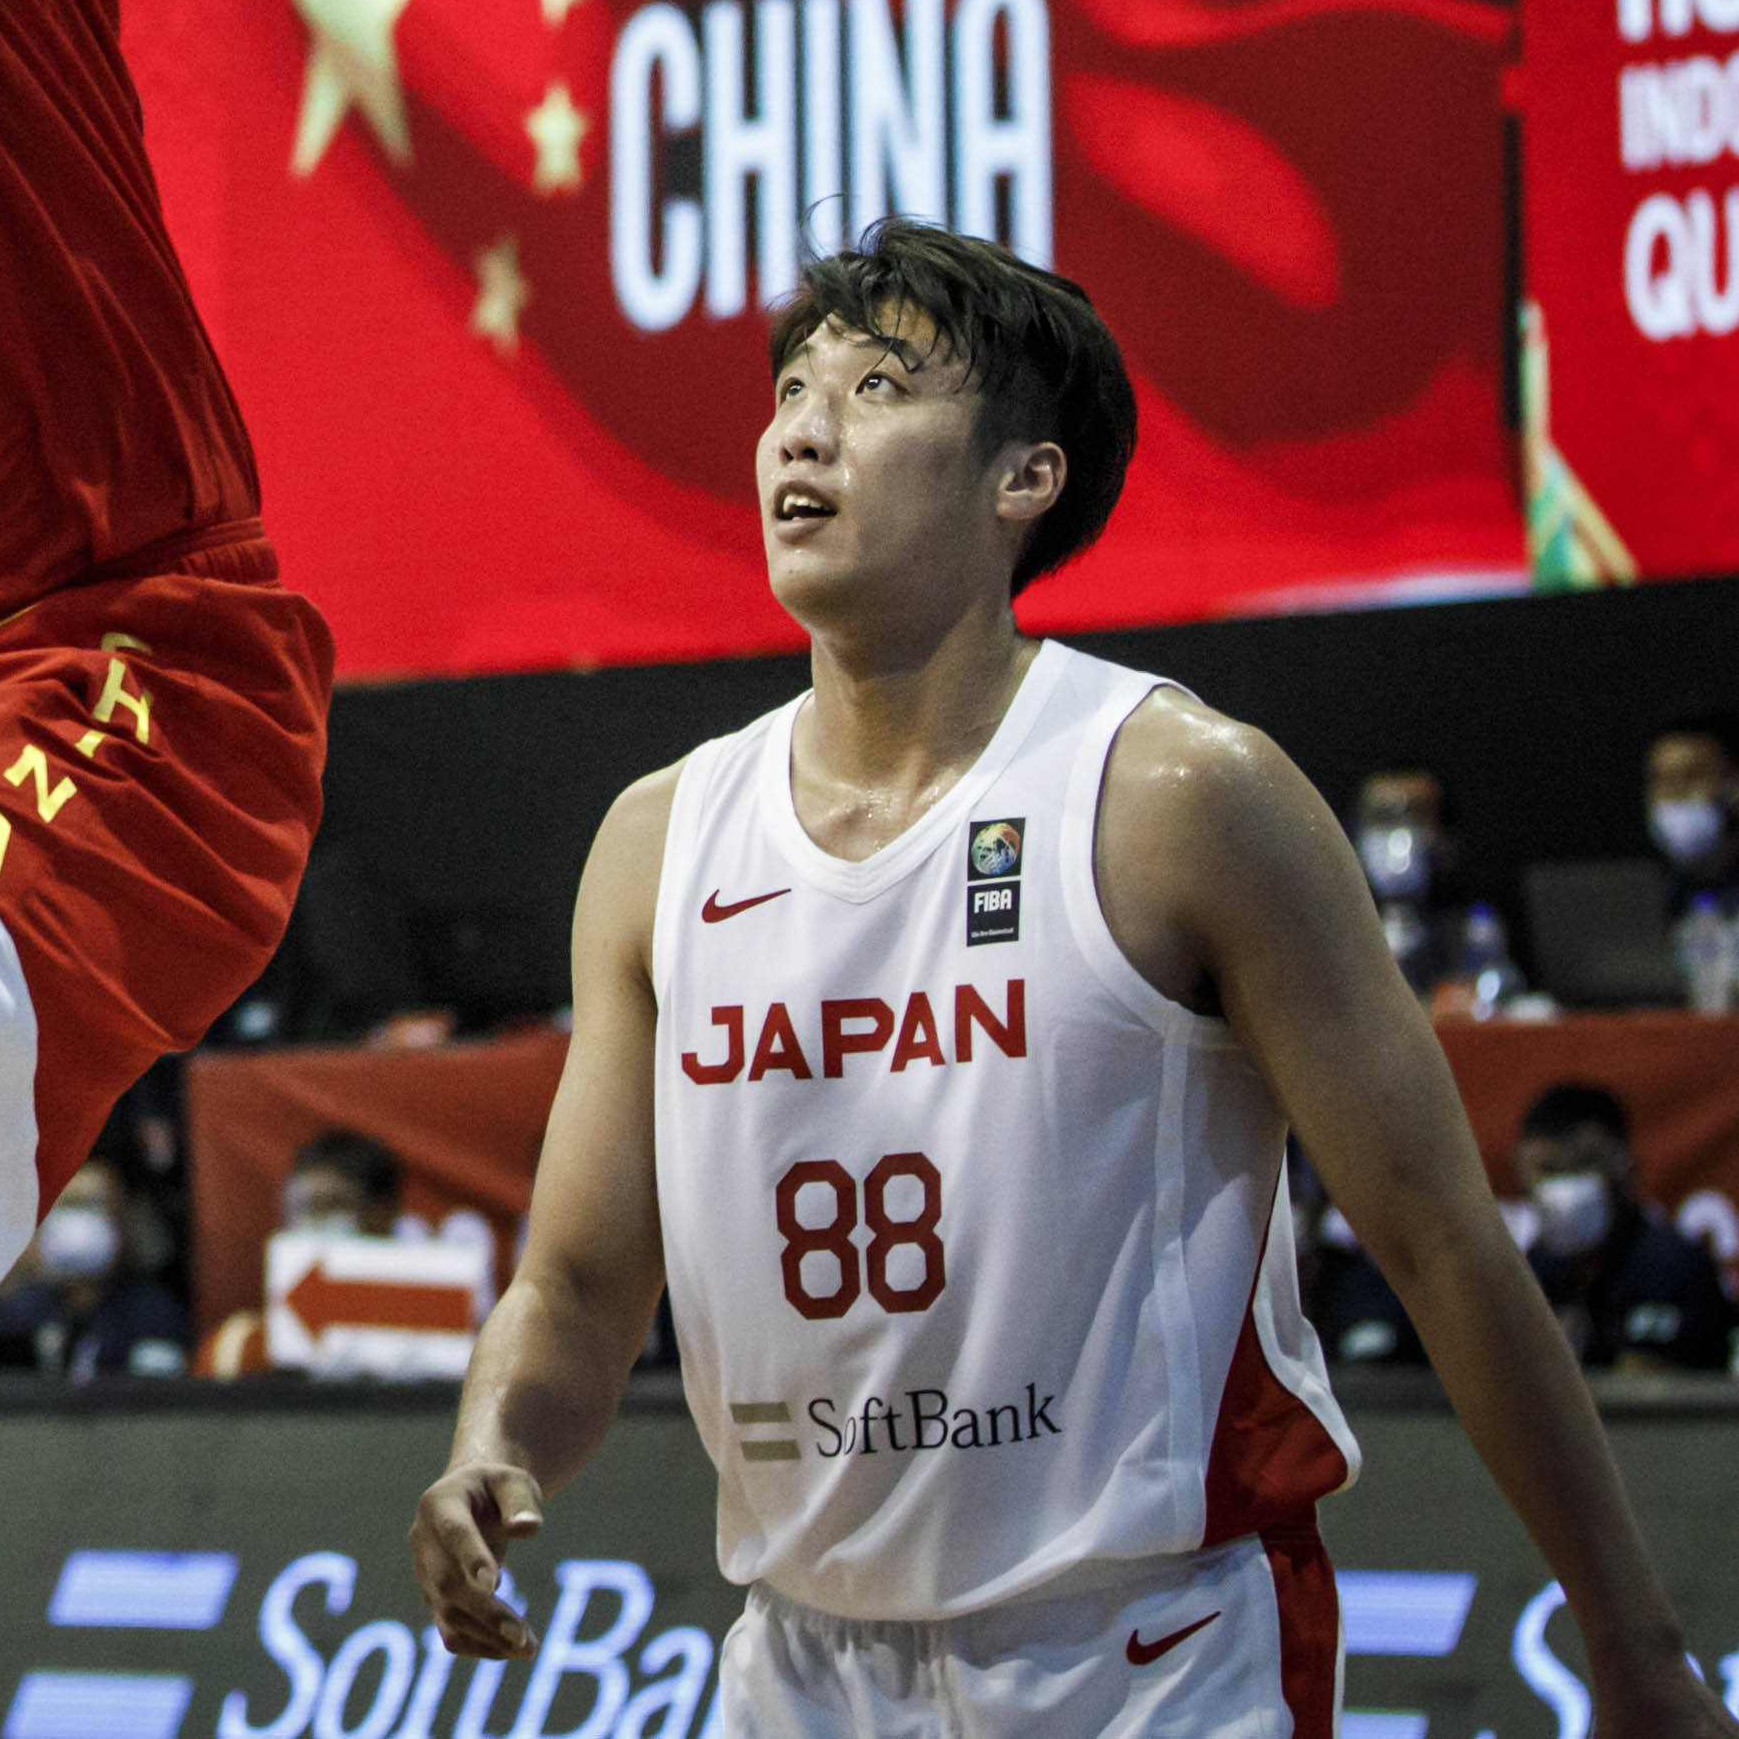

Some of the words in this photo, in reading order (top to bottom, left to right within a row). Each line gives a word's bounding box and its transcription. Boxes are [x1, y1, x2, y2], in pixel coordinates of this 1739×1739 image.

[973, 888, 1012, 914] FIBA
[681, 978, 1027, 1085] JAPAN
[775, 1151, 946, 1321] 88
[808, 1383, 1062, 1459] SoftBank
